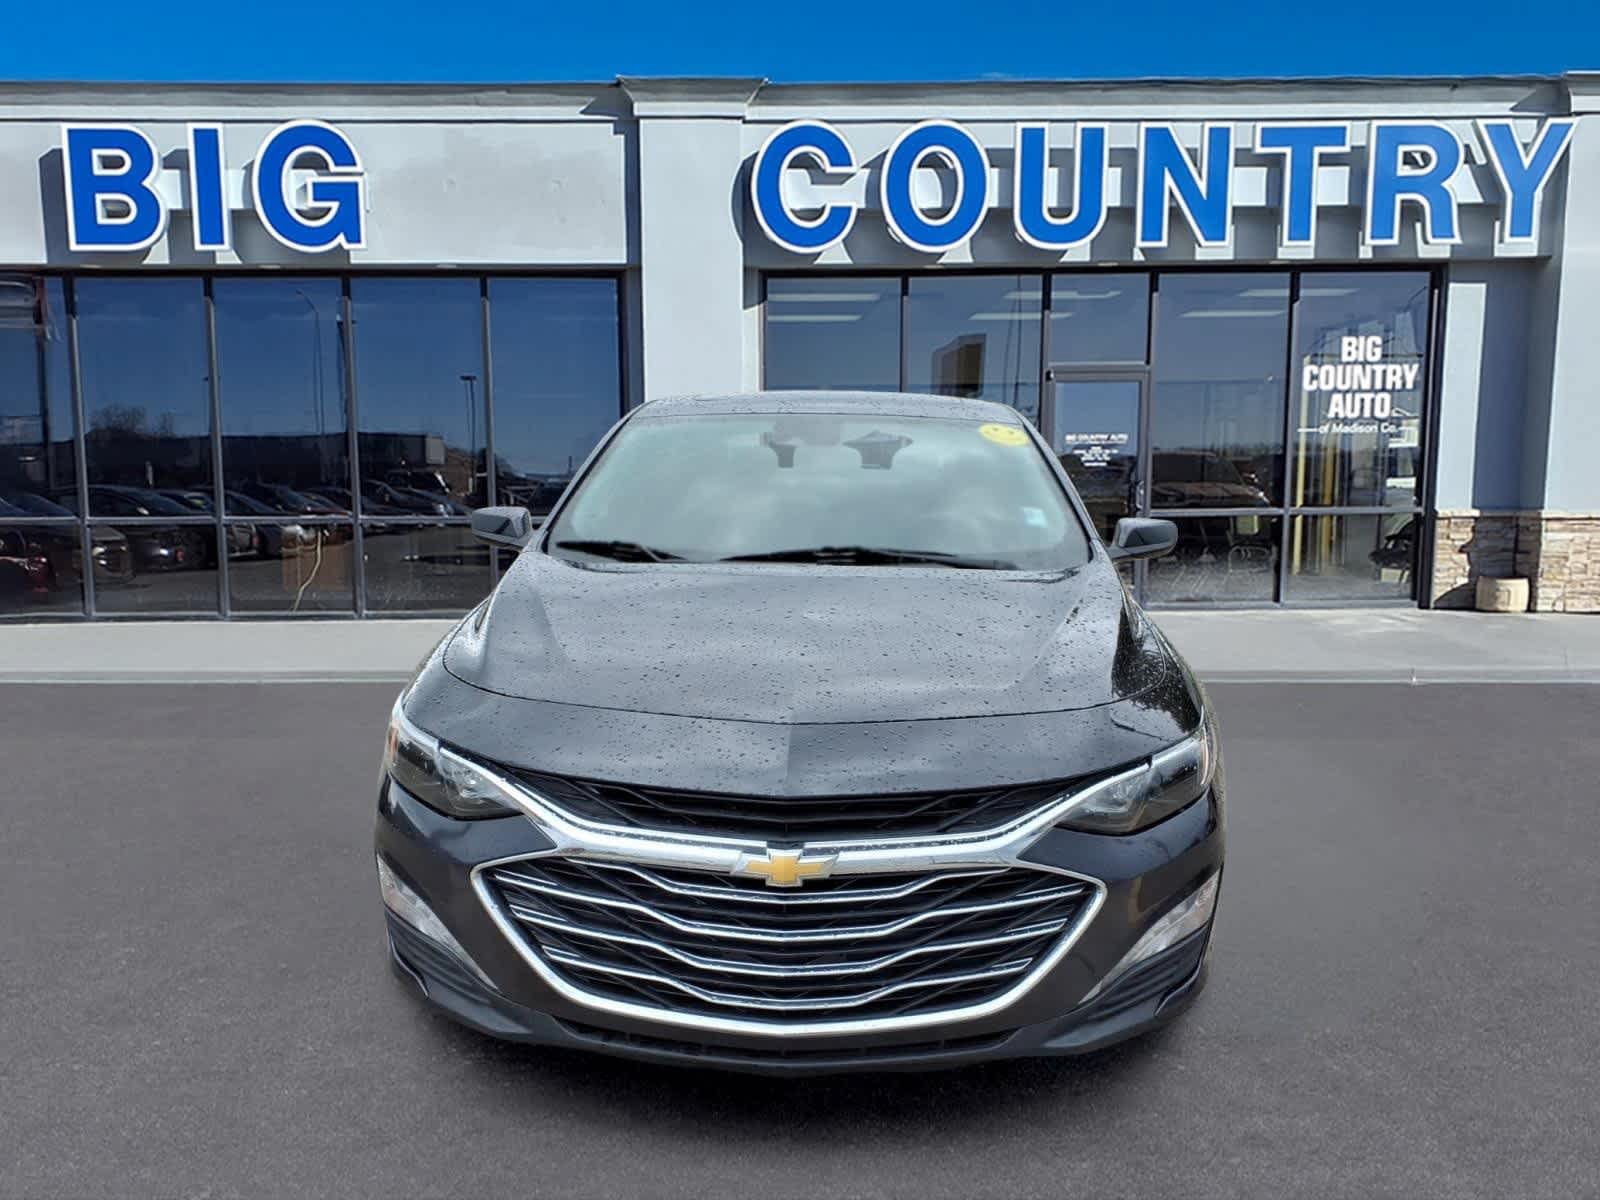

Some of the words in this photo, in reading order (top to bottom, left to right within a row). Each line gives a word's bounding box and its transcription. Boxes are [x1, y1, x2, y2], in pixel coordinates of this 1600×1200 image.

[62, 119, 367, 254] BIG
[751, 119, 1574, 254] COUNTRY
[1341, 336, 1382, 362] BIG
[1303, 363, 1419, 391] COUNTRY
[1328, 392, 1391, 419] AUTO
[1331, 421, 1378, 433] Madison
